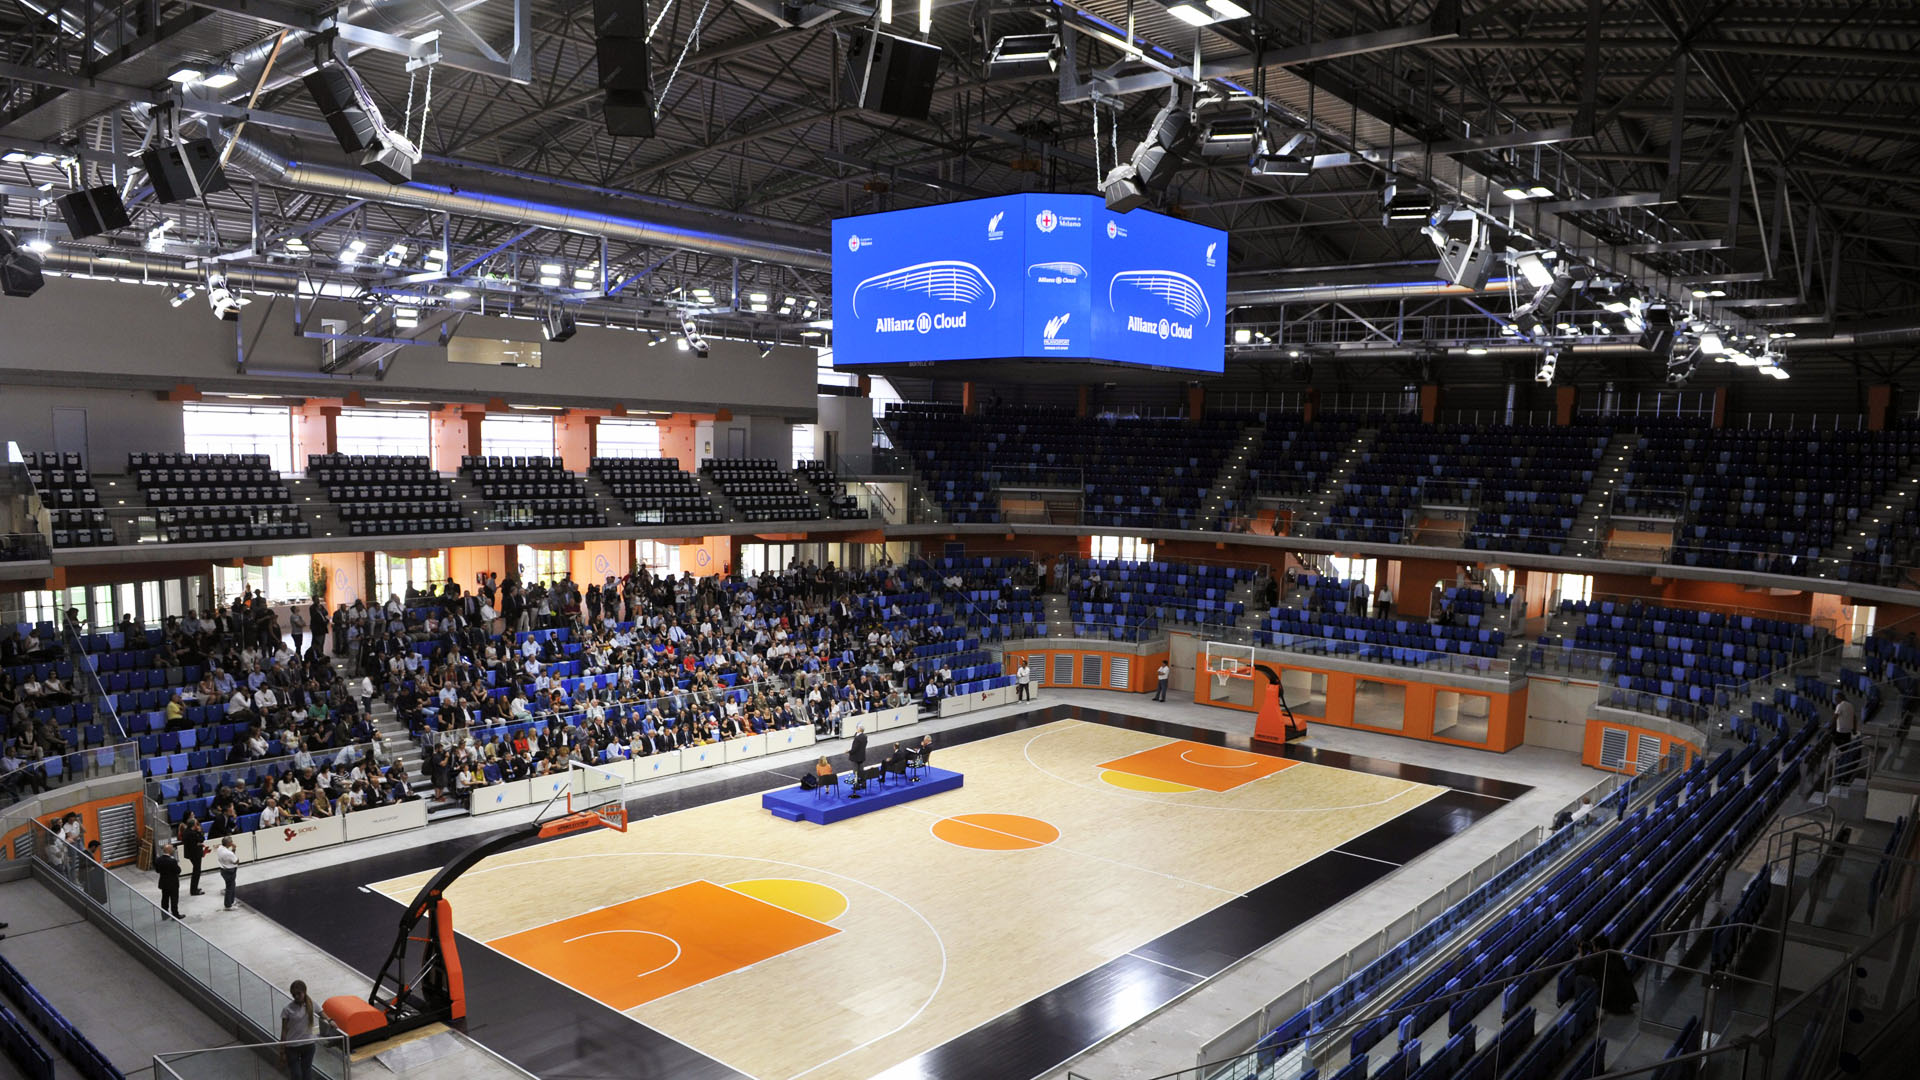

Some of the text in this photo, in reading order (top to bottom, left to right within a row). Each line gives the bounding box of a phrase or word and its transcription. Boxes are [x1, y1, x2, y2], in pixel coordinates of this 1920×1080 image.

[875, 311, 966, 333] Allianz Cloud
[1127, 315, 1193, 340] Allianz Cloud
[1030, 492, 1042, 500] B1
